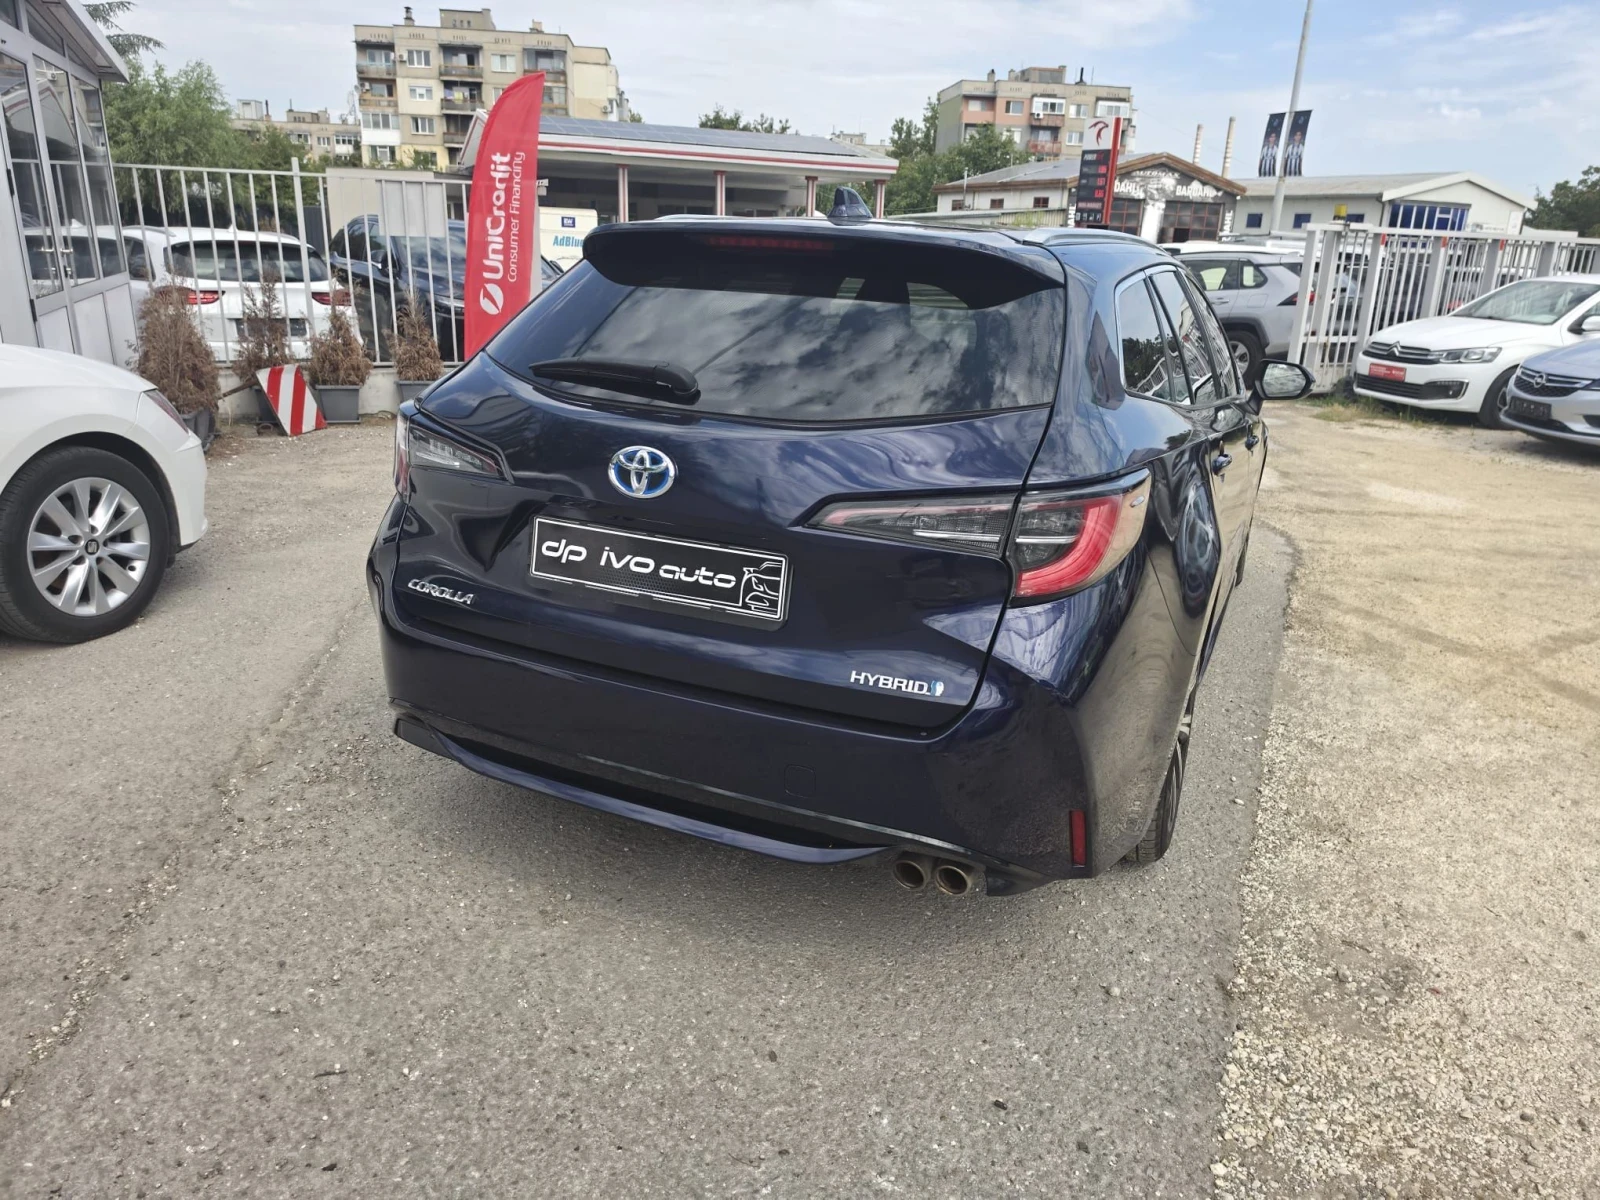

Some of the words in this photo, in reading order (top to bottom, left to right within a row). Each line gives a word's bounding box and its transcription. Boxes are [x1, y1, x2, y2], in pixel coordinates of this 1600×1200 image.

[509, 152, 526, 215] Financing
[482, 152, 513, 280] UniCredit
[507, 215, 521, 283] Consumer
[407, 578, 475, 605] COROLLA
[541, 539, 588, 564] dp
[600, 547, 656, 574] ivo
[659, 564, 737, 589] auto
[849, 670, 930, 696] HYBRID
